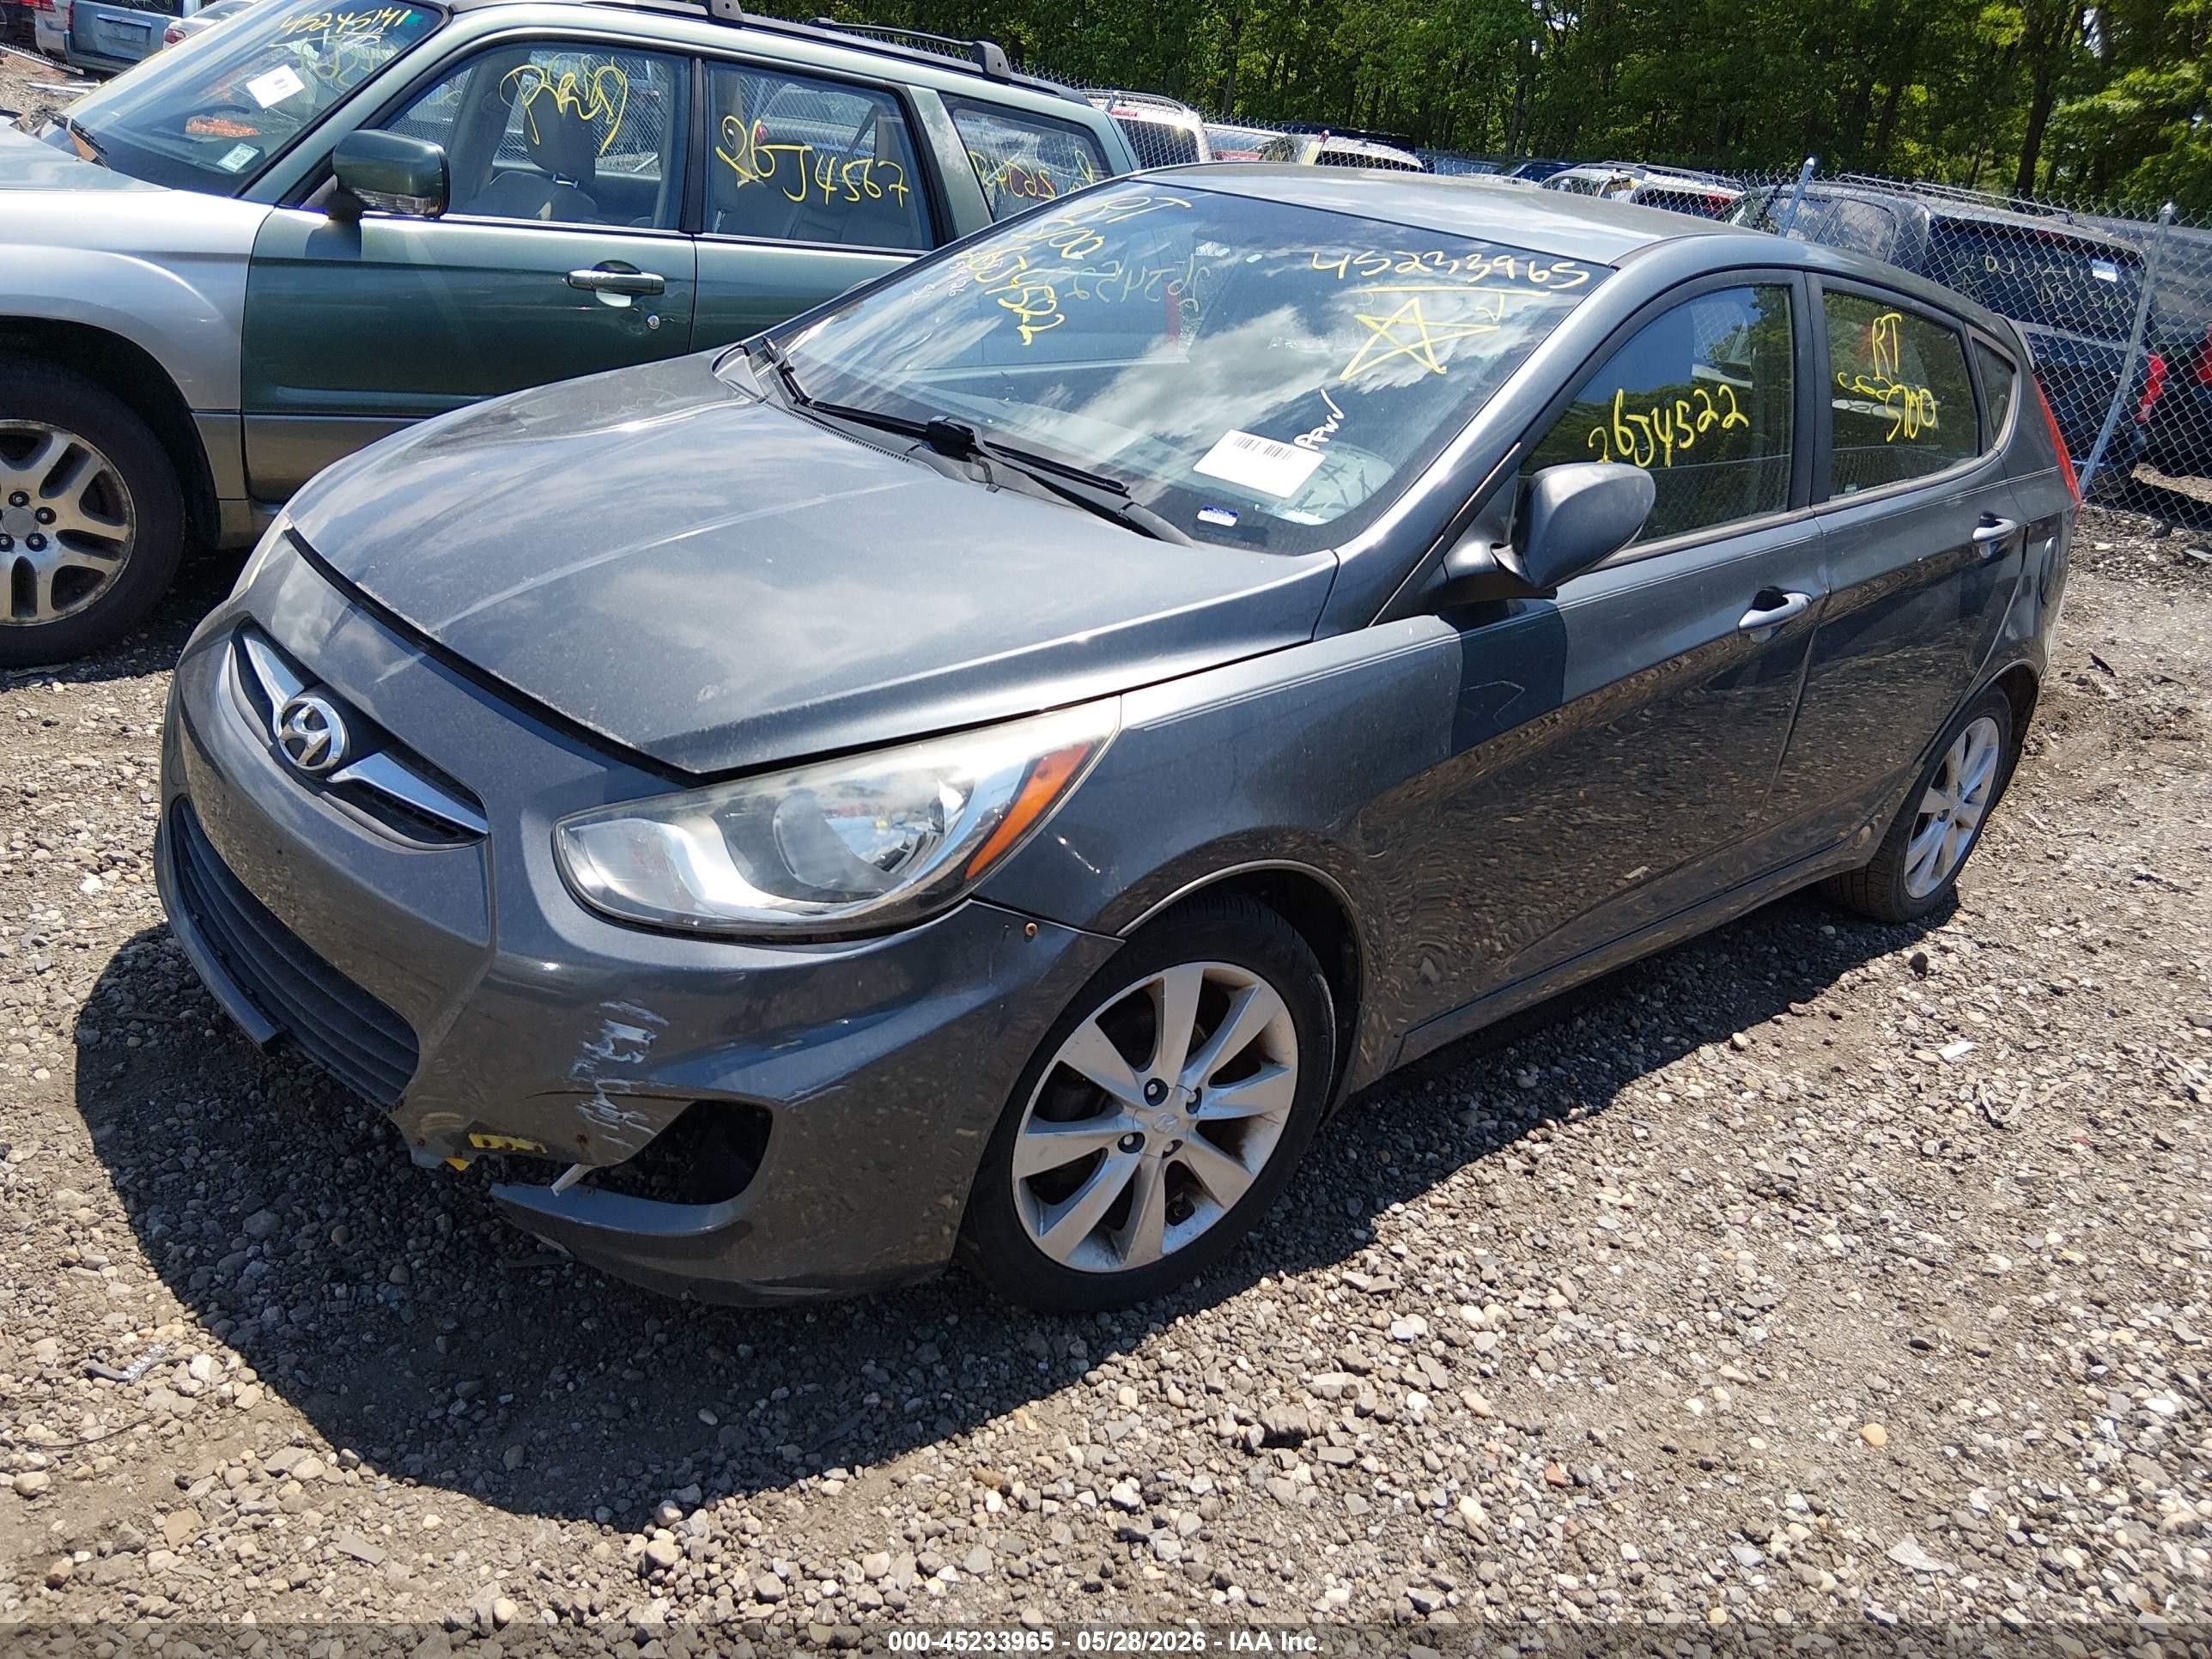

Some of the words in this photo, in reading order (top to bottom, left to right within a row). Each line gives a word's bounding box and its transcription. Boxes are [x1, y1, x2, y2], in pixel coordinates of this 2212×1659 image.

[715, 114, 909, 208] 26J4567
[1311, 250, 1590, 289] 45233965
[1588, 384, 1750, 468] 26J4522
